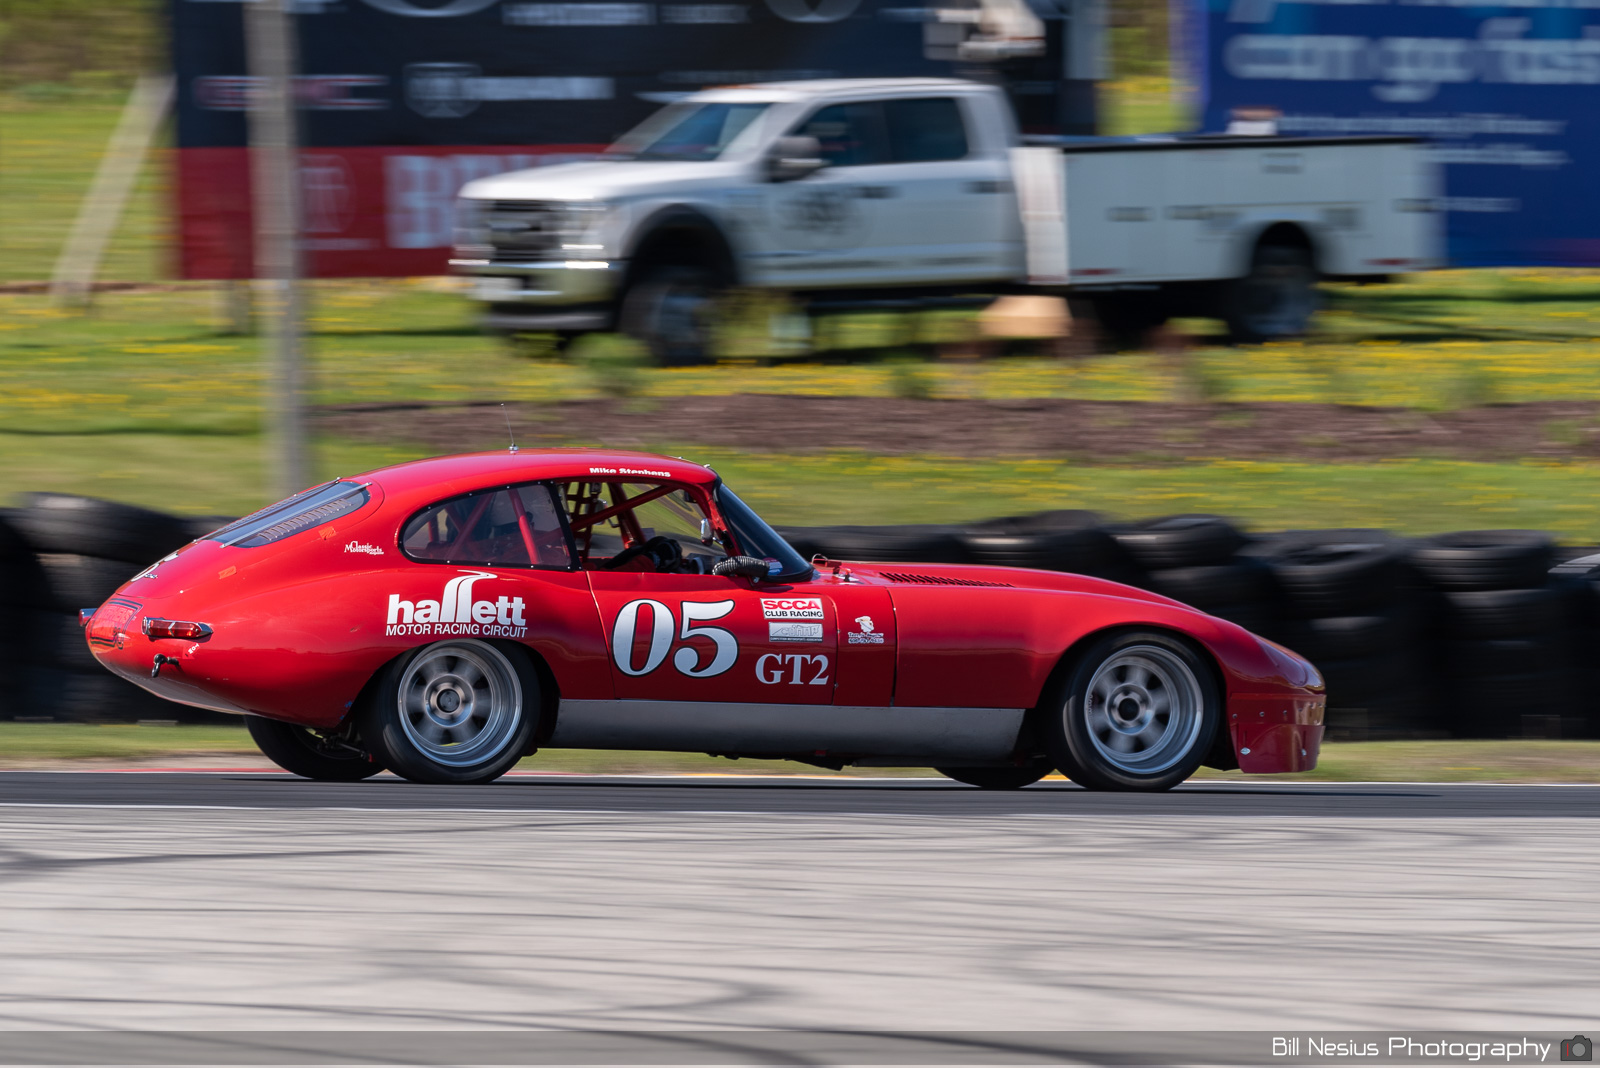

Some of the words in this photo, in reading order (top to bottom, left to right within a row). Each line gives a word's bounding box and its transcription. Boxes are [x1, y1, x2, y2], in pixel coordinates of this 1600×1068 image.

[387, 569, 526, 626] hallett
[763, 600, 821, 610] SCCA
[789, 610, 823, 618] RACING
[386, 624, 431, 636] MOTOR
[434, 624, 480, 636] RACING
[482, 625, 528, 638] CIRCUIT
[611, 598, 740, 679] 05
[755, 653, 830, 685] GT2
